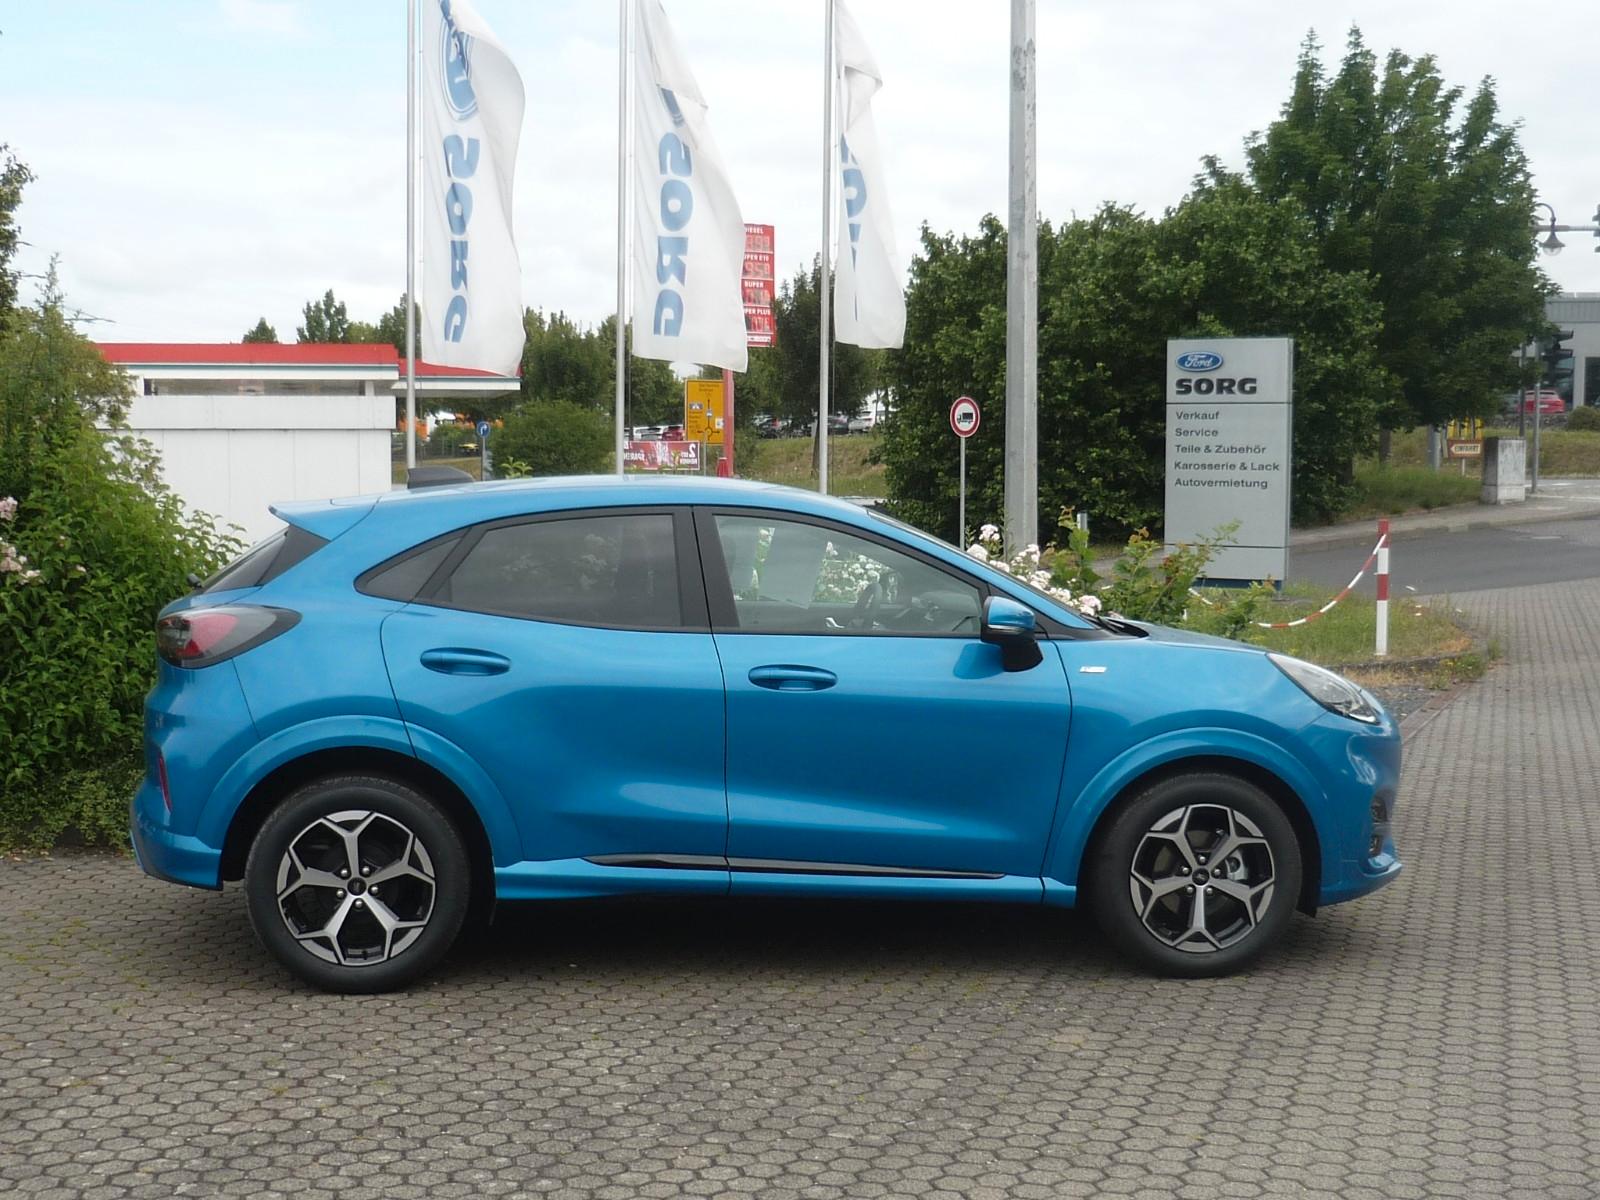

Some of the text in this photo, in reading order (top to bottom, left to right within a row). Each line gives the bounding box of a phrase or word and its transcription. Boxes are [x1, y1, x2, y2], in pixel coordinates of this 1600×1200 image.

[744, 280, 764, 288] SUPER
[1184, 354, 1213, 368] Ford
[1175, 377, 1257, 395] SORG
[1175, 411, 1220, 421] Verkauf
[1175, 428, 1219, 437] Service
[1175, 444, 1266, 455] Teile & Zubehör
[1174, 461, 1280, 472] Karosserie & Lack
[1174, 478, 1268, 490] Autovermietung
